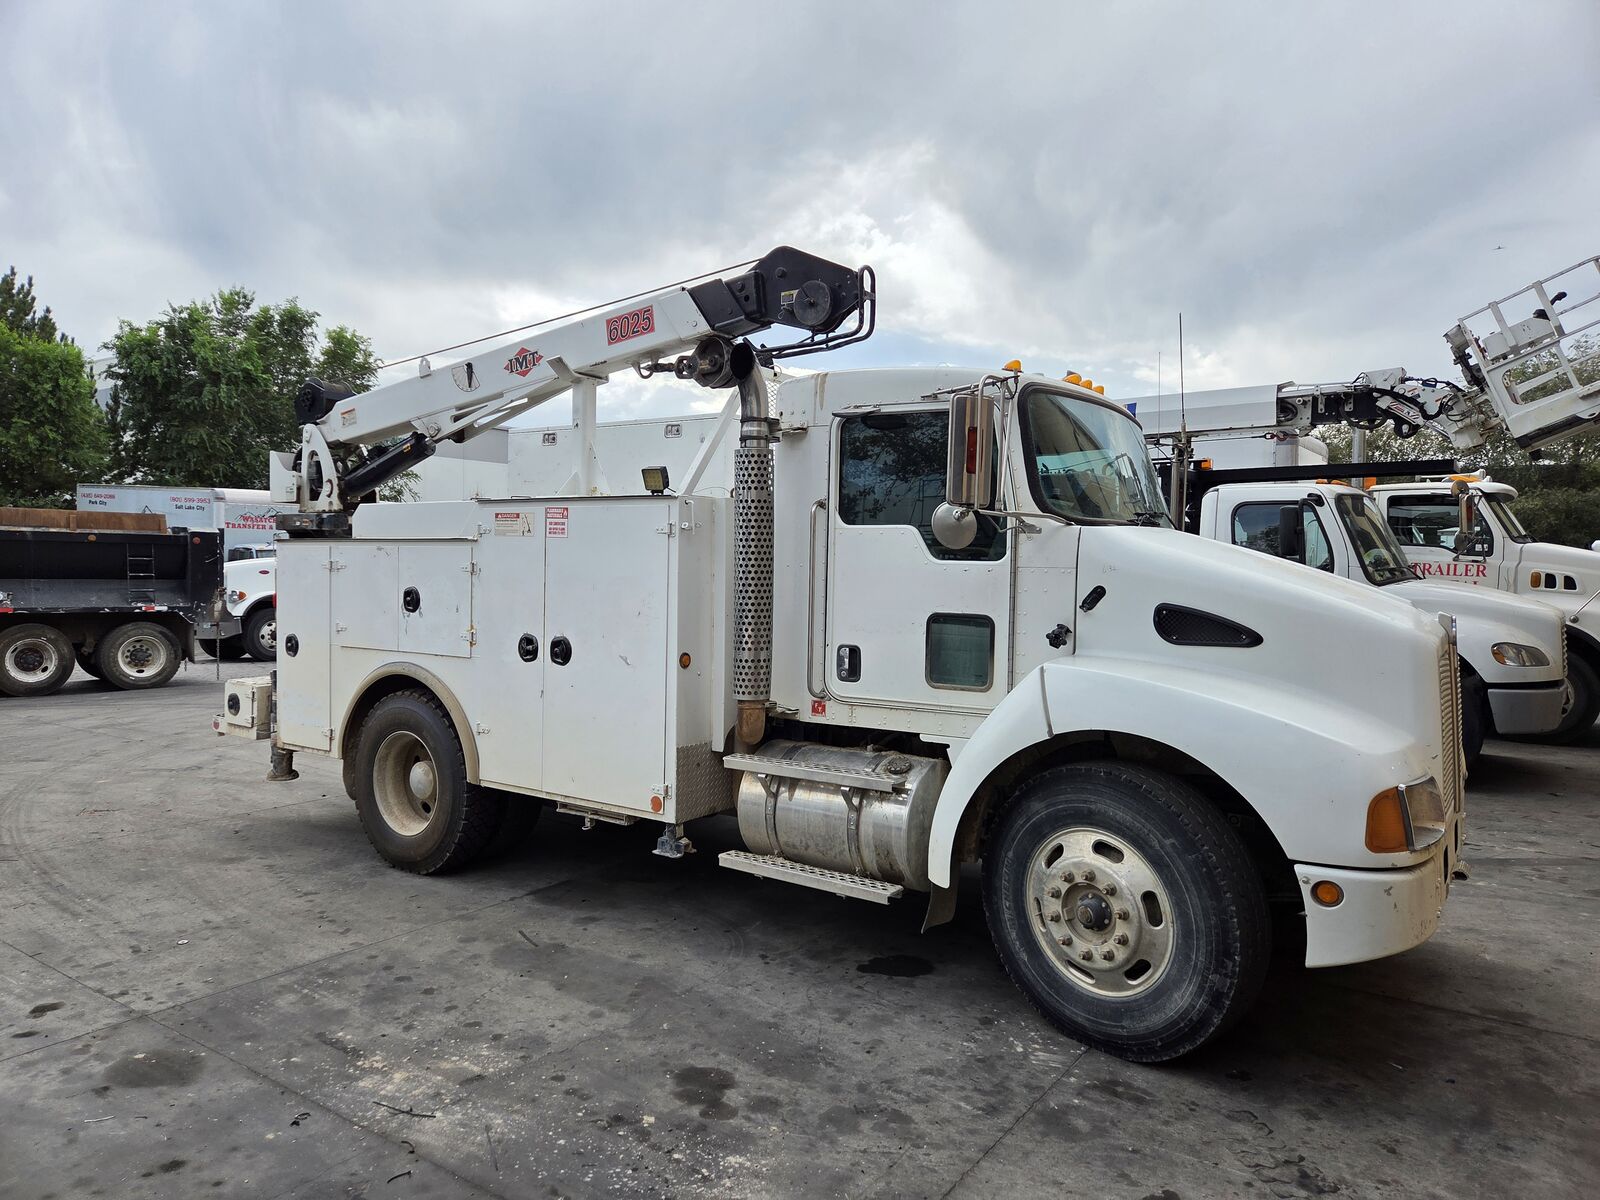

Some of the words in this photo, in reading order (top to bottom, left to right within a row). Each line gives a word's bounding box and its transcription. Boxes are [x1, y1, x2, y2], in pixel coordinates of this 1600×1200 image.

[609, 308, 652, 342] 6025
[508, 351, 539, 373] IMT
[224, 521, 266, 529] TRANSFER
[1411, 562, 1487, 577] TRAILER
